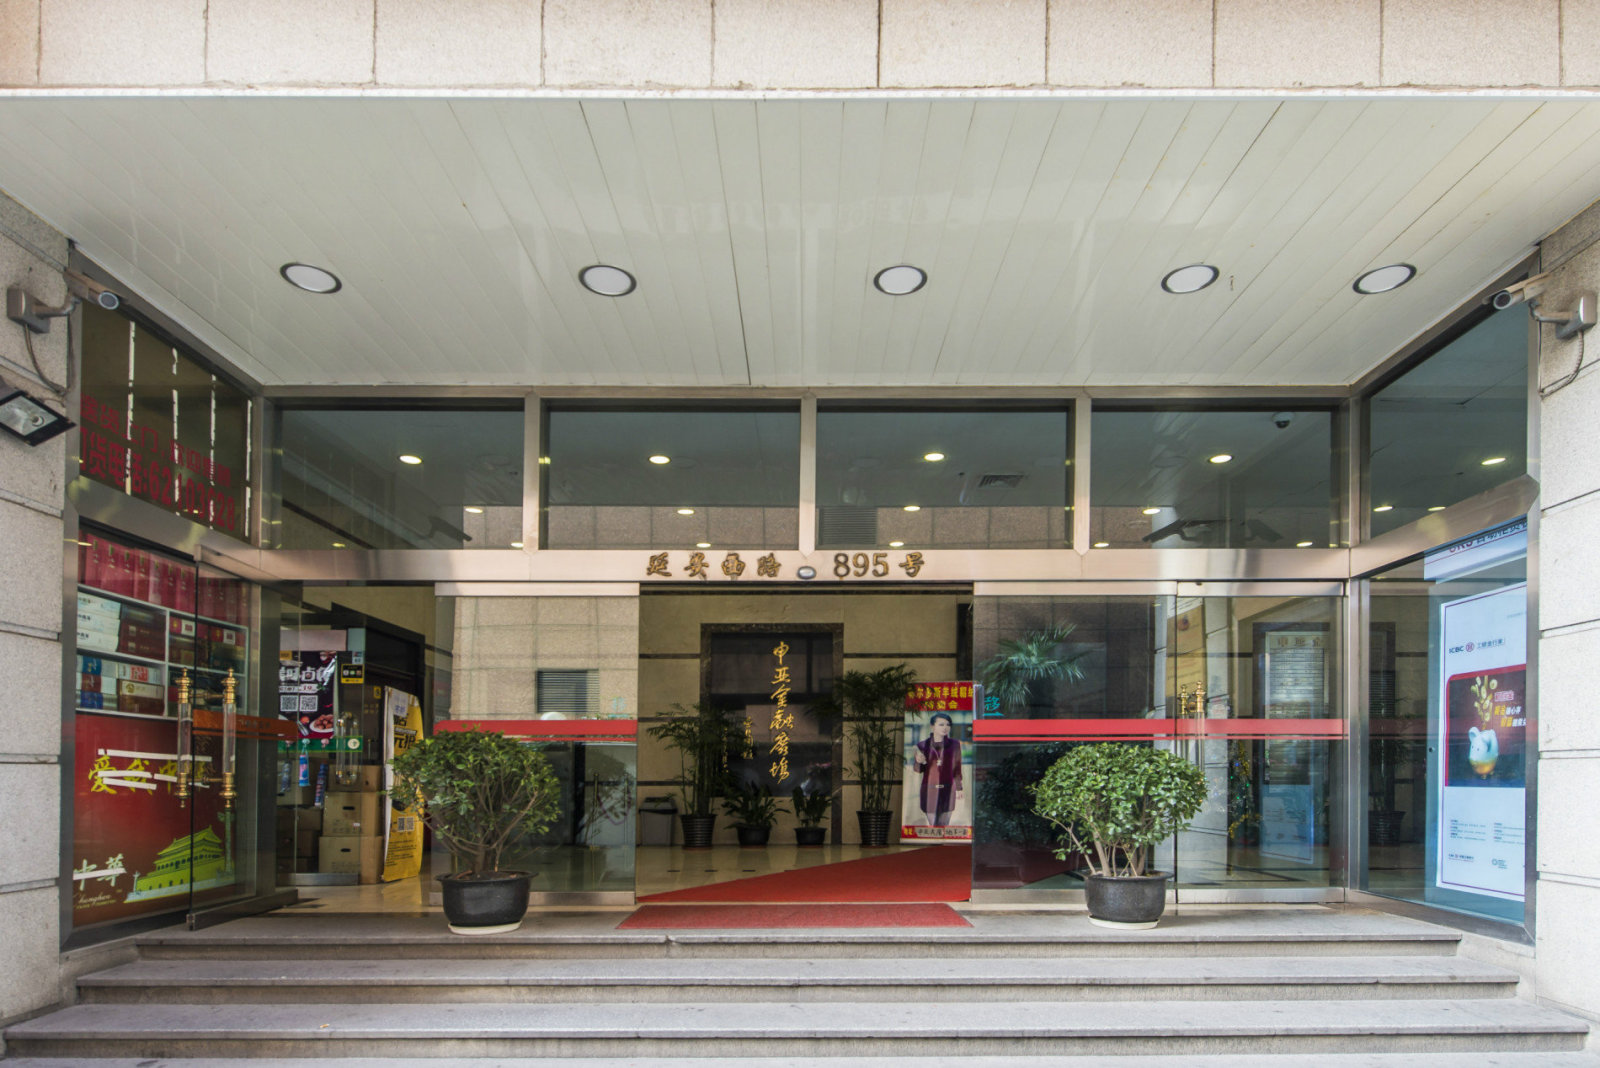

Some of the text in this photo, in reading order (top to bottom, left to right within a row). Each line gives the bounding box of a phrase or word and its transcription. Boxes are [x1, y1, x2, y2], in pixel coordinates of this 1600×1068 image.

[646, 552, 925, 579] 延安西路 895号
